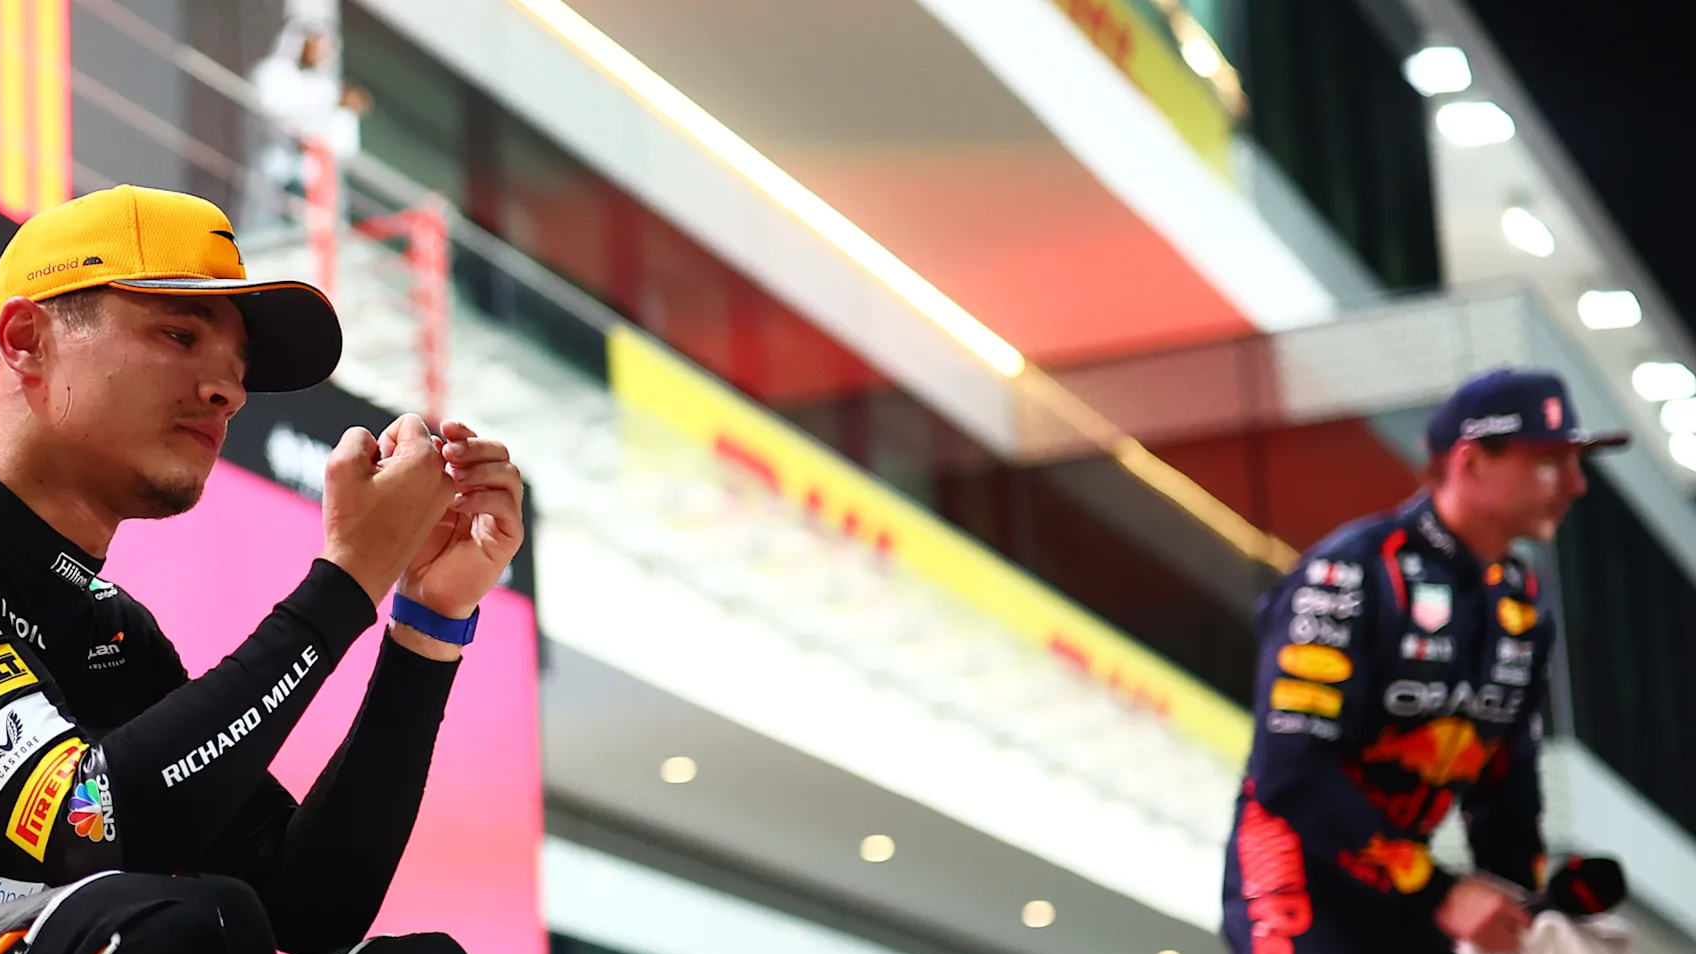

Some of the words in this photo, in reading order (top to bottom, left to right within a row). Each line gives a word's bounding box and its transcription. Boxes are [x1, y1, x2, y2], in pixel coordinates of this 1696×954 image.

[26, 257, 80, 282] android
[56, 558, 88, 586] Hilton
[161, 706, 262, 788] RICHARD
[261, 645, 319, 714] MILLE
[96, 773, 116, 842] CNBC
